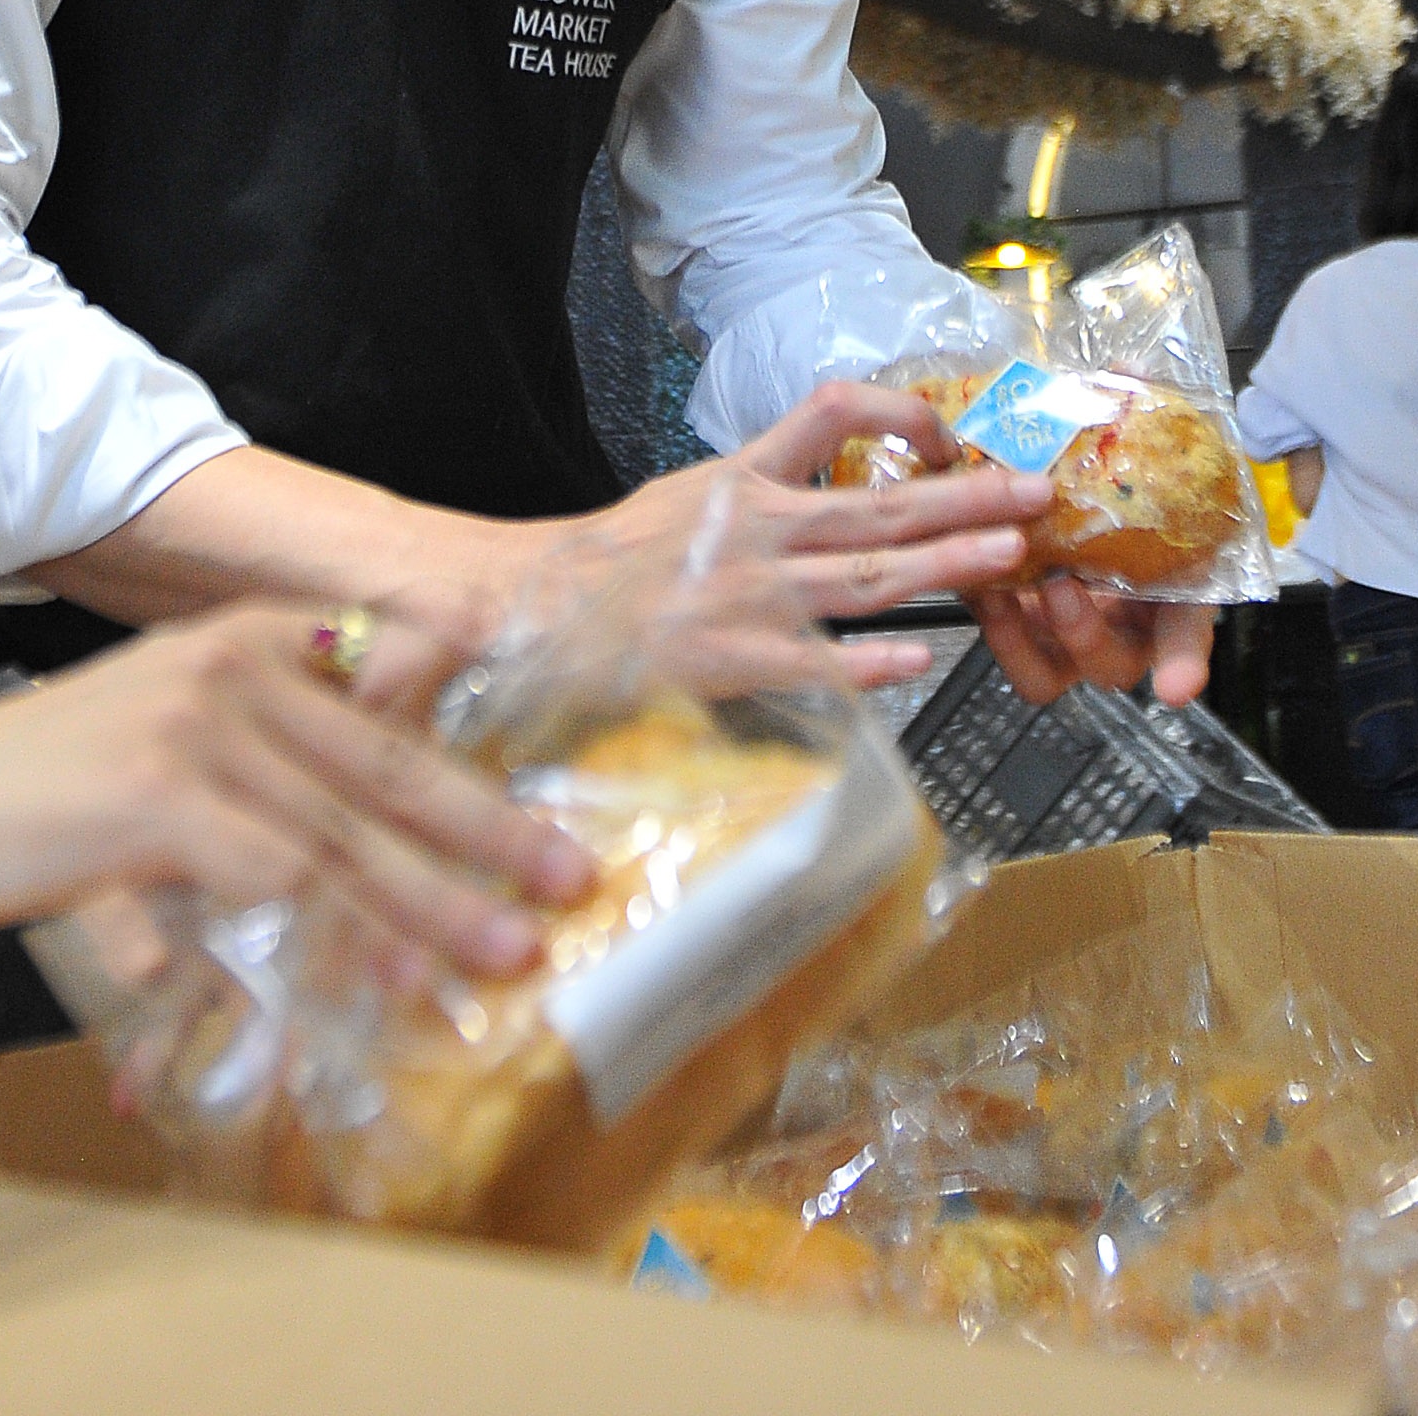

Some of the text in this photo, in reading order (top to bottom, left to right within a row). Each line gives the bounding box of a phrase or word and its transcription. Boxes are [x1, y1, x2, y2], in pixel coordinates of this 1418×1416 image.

[513, 7, 611, 44] MARKET
[508, 42, 617, 78] TEA HOUSE
[1011, 377, 1042, 450] CKE
